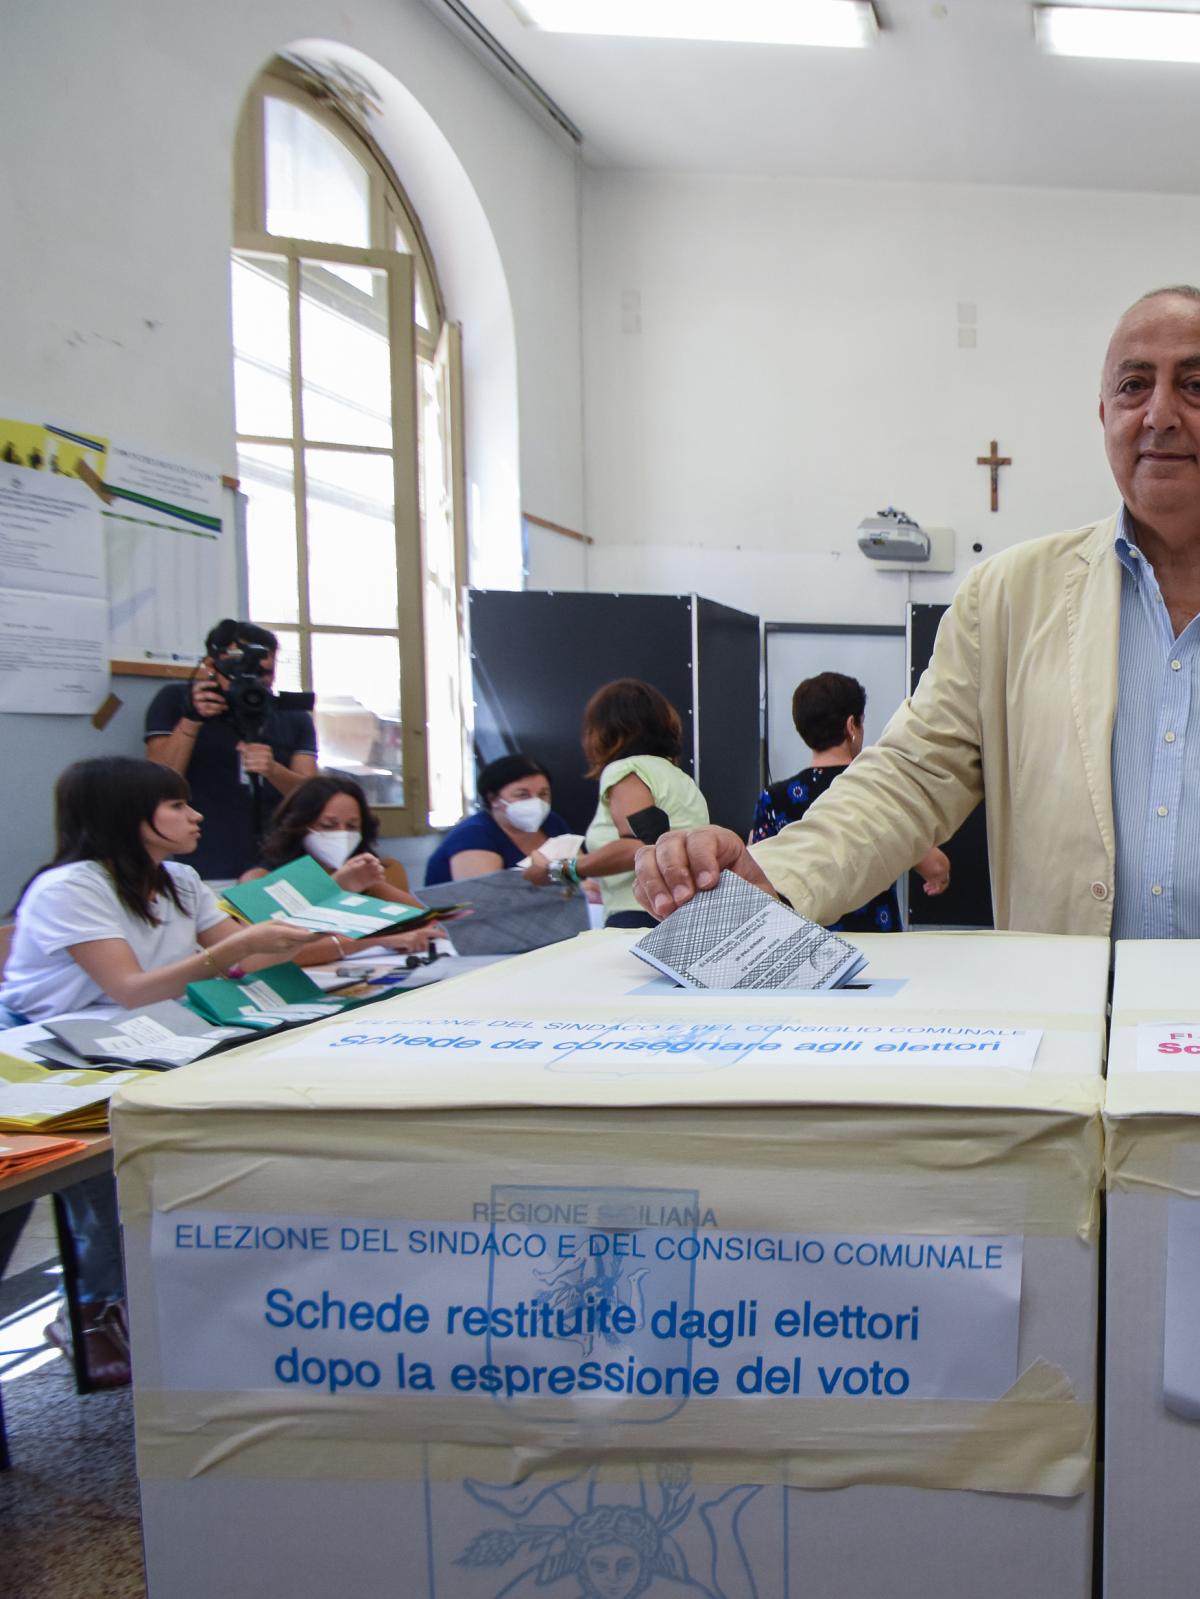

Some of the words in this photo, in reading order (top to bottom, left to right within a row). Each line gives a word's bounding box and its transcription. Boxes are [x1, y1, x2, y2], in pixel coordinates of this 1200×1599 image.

[329, 1032, 481, 1050] Schede
[490, 1037, 543, 1051] da
[552, 1037, 782, 1054] consegnare
[793, 1039, 861, 1054] agli
[873, 1040, 1001, 1054] elettori
[488, 1020, 536, 1029] DEL
[544, 1021, 662, 1032] SINDACO
[690, 1023, 737, 1032] DEL
[745, 1023, 883, 1034] CONSIGLIO
[889, 1026, 1028, 1037] COMUNALE
[472, 1202, 589, 1225] REGIONE
[175, 1225, 329, 1251] ELEZIONE
[340, 1228, 399, 1253] DEL
[408, 1230, 547, 1258] SINDACO
[557, 1234, 576, 1259] E
[588, 1233, 646, 1259] DEL
[655, 1237, 825, 1264] CONSIGLIO
[833, 1243, 1003, 1270] COMUNALE
[264, 1287, 430, 1335] Schede
[447, 1296, 637, 1340] restituite
[651, 1300, 757, 1349] dagli
[774, 1300, 920, 1342] elettori
[274, 1346, 381, 1396] dopo
[397, 1352, 435, 1391] la
[450, 1355, 720, 1398] espressione
[736, 1356, 801, 1396] del
[817, 1360, 910, 1396] voto
